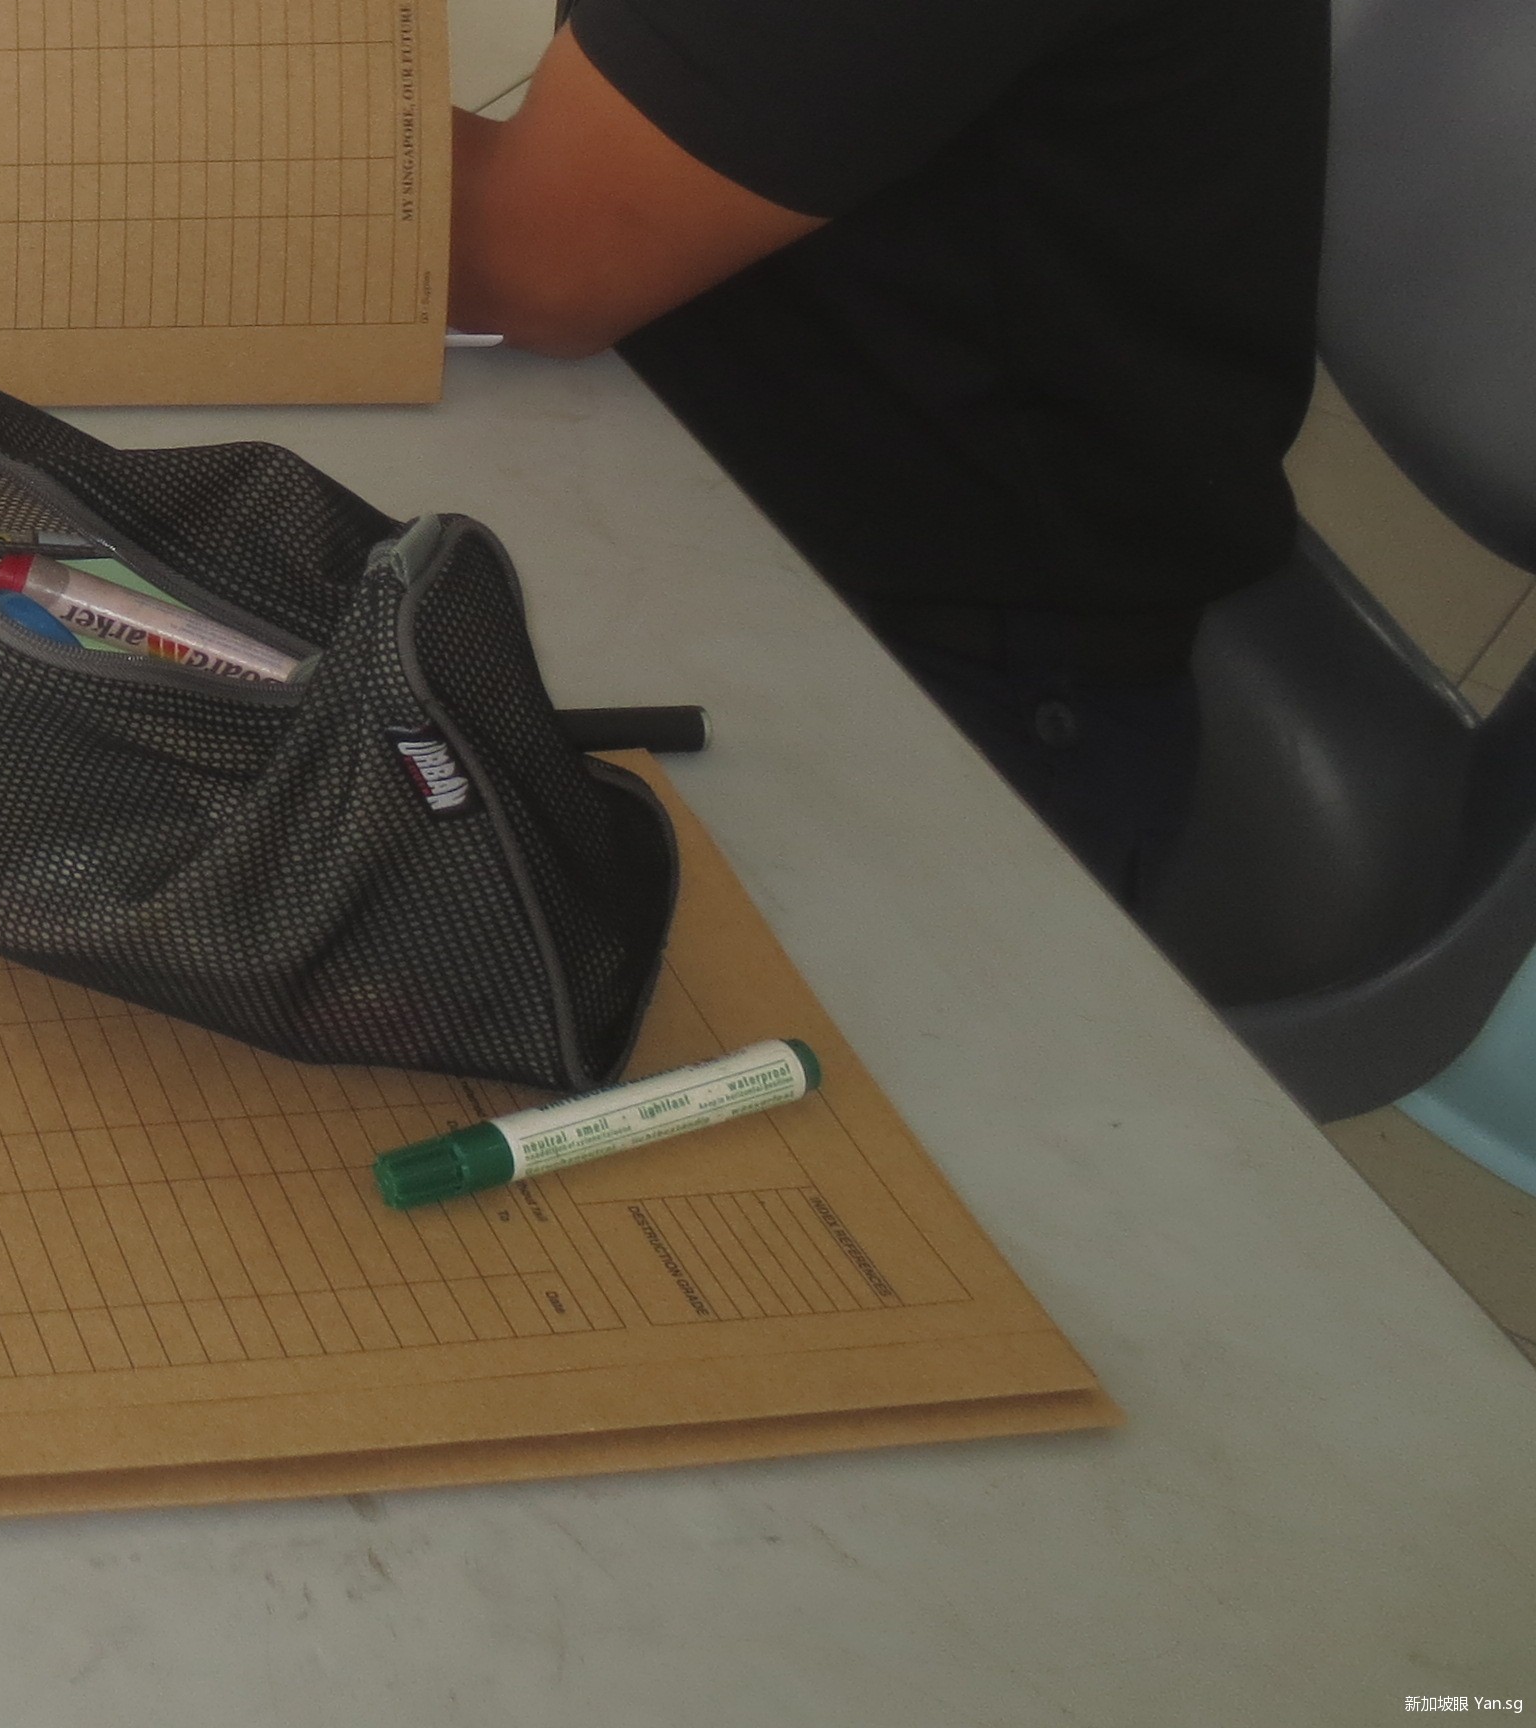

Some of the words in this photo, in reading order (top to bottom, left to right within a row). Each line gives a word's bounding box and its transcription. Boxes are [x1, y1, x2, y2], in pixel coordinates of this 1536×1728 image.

[400, 7, 412, 63] FUTURE
[403, 70, 414, 100] OUR
[401, 104, 415, 195] SINGAPORE,
[402, 200, 413, 221] MY
[628, 1205, 681, 1278] DESTRUCTION
[676, 1278, 709, 1317] GRADE
[810, 1196, 837, 1228] INDEX
[834, 1228, 892, 1297] REFERENCES
